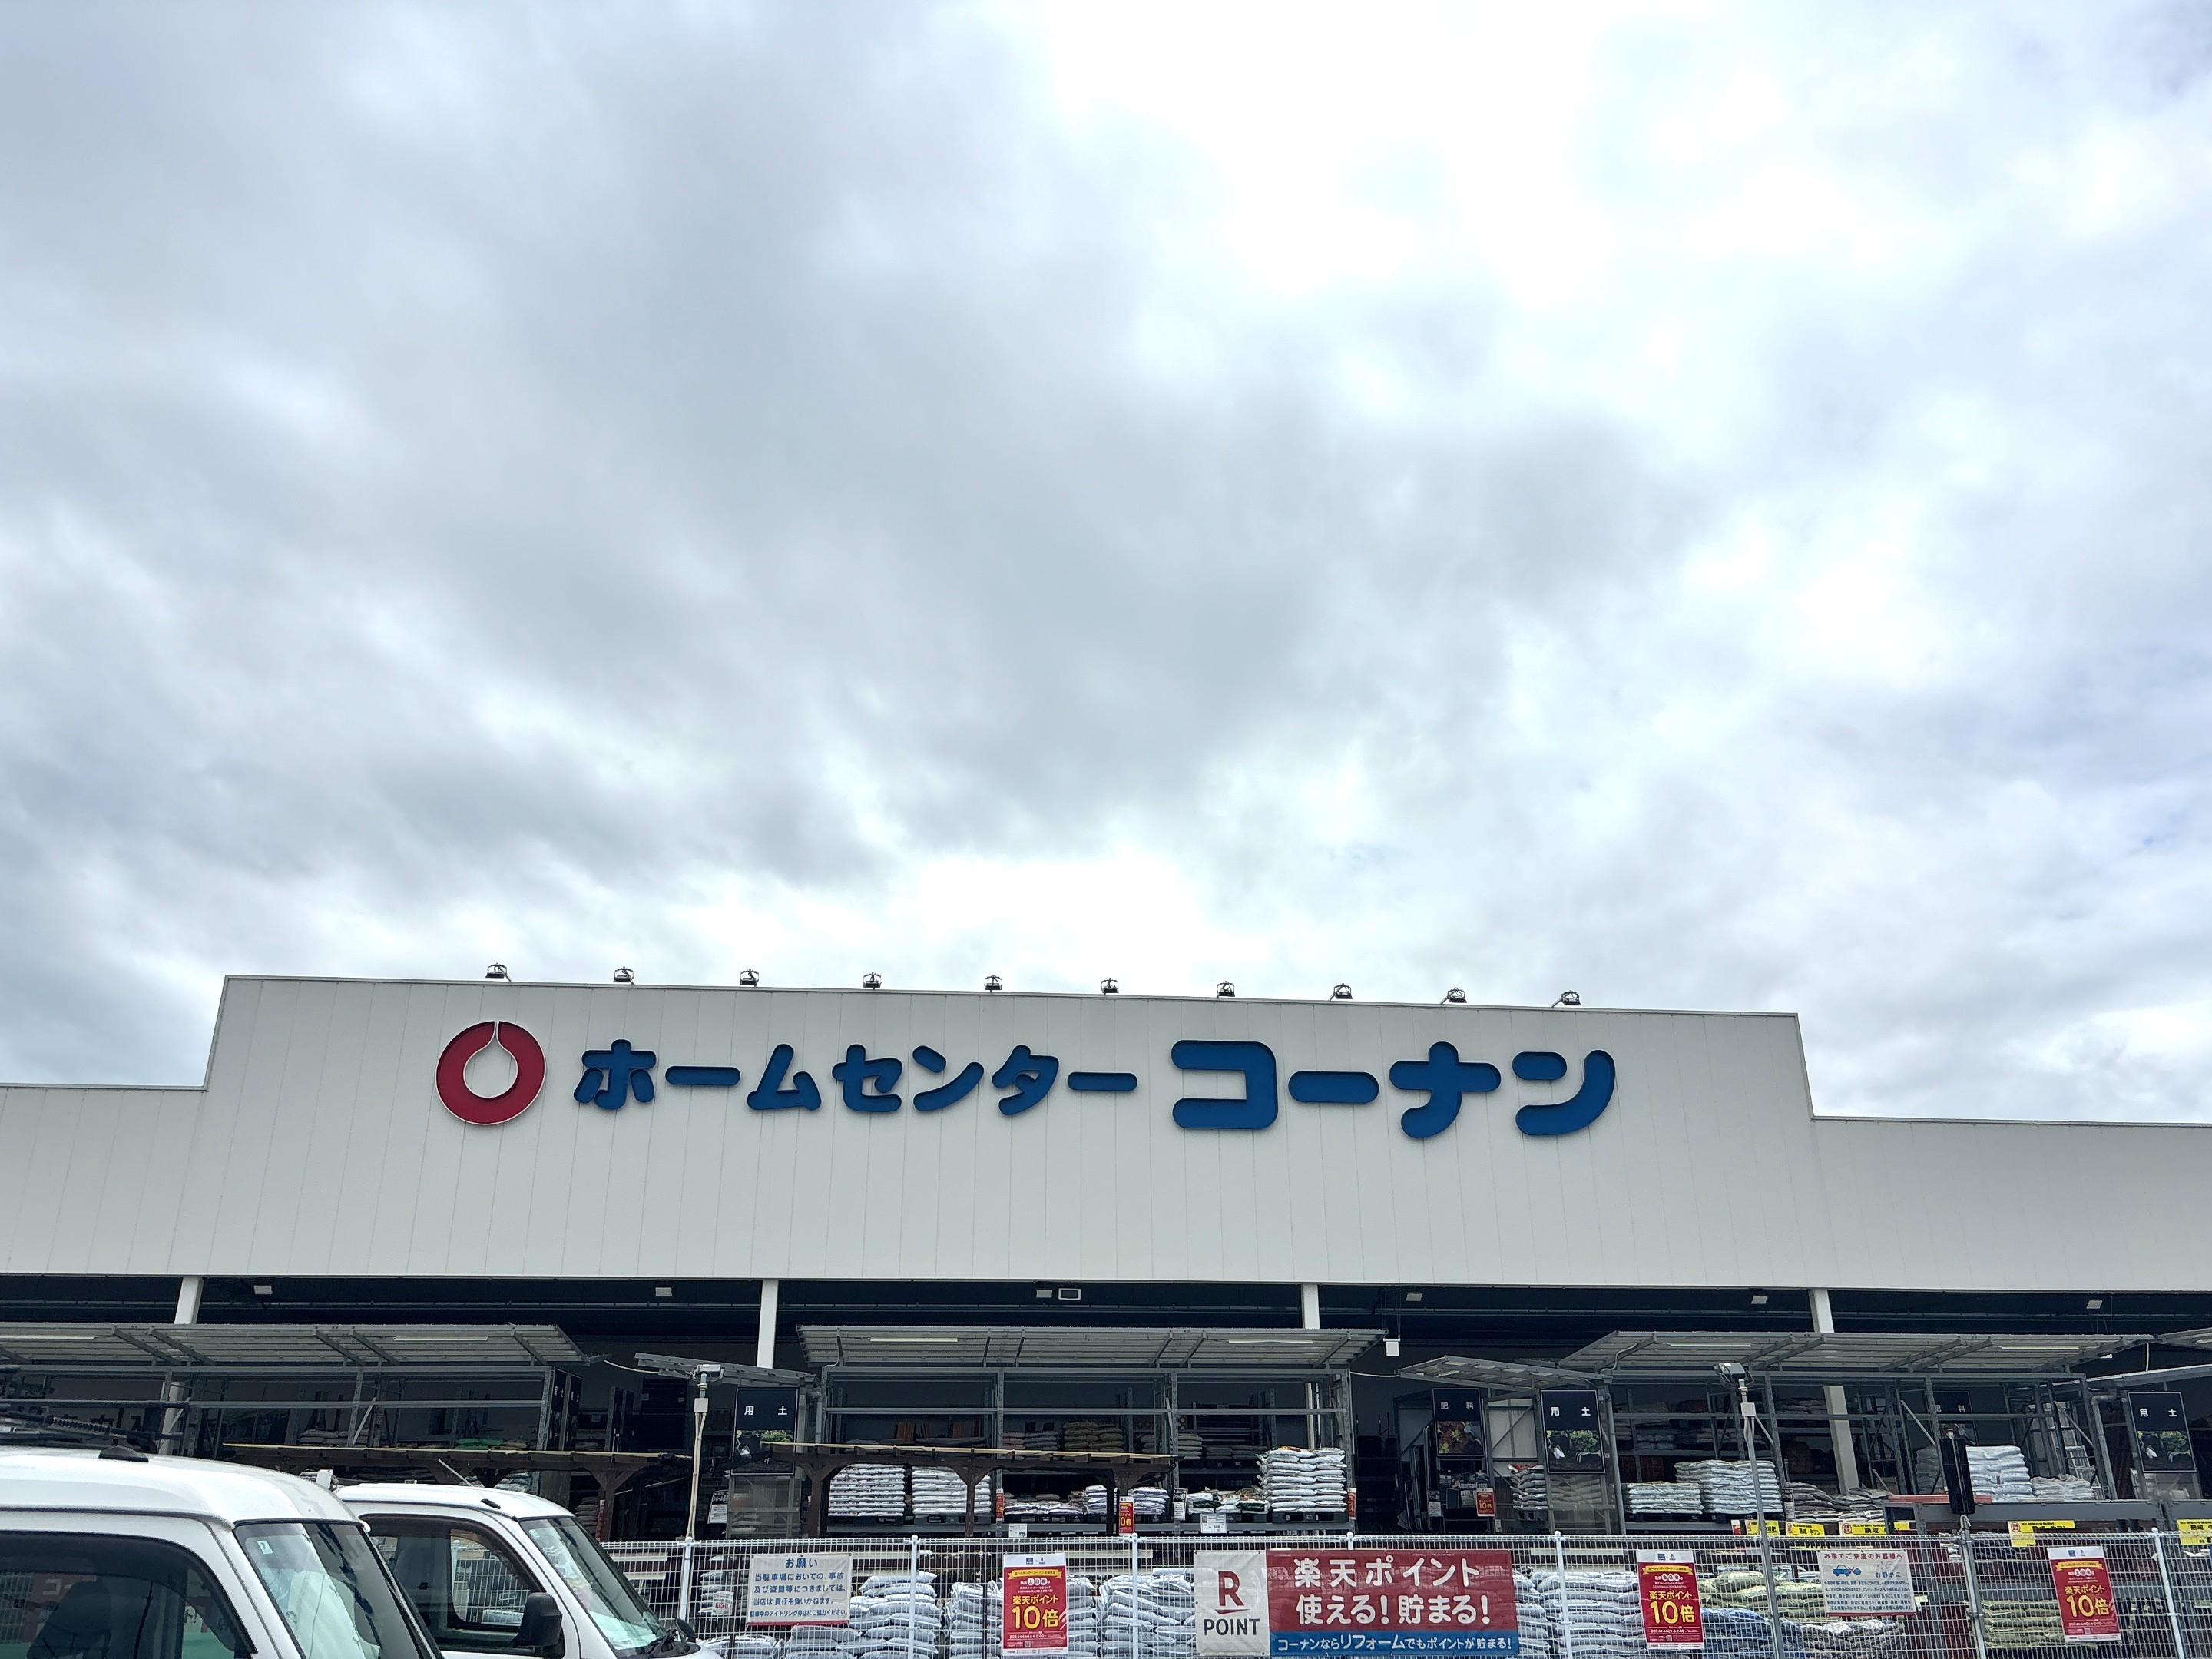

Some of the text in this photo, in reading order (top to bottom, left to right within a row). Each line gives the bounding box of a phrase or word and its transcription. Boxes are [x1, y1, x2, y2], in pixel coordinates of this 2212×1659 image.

[574, 1040, 1616, 1139] ホームセンター コーナン
[744, 1406, 788, 1416] 用土
[1551, 1406, 1591, 1416] 用土
[2139, 1408, 2177, 1418] 用土
[785, 1558, 817, 1568] お願い
[1294, 1555, 1479, 1588] 楽天ポイント
[1218, 1570, 1243, 1606] R
[1649, 1590, 1692, 1600] 楽天ポイント
[2064, 1584, 2105, 1594] 楽天ポイント
[1013, 1594, 1059, 1605] 楽天ポイント
[2066, 1594, 2110, 1618] 10倍
[1012, 1605, 1058, 1629] 10倍
[1650, 1601, 1695, 1624] 10倍
[1204, 1618, 1260, 1636] POINT
